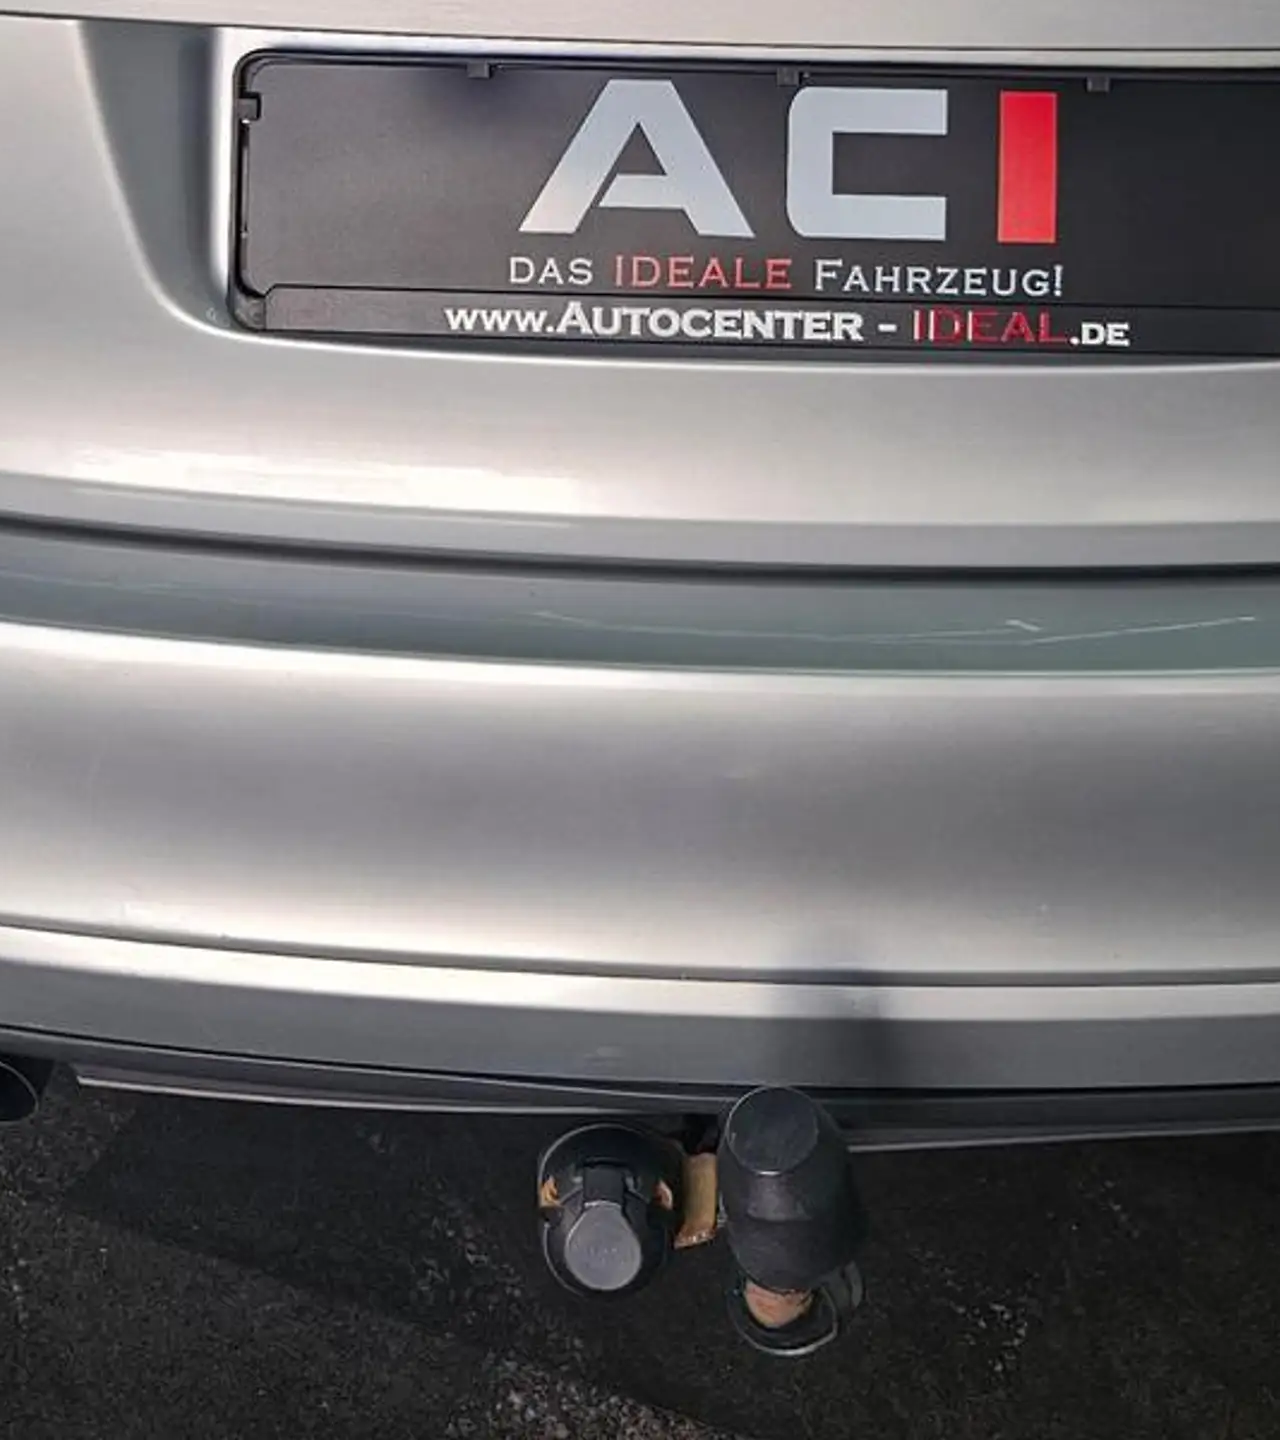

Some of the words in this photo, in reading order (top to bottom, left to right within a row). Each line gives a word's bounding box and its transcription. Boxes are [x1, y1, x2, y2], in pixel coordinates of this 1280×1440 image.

[517, 78, 1058, 244] ACI
[508, 256, 594, 286] DAS
[614, 255, 793, 289] IDEALE
[813, 258, 1064, 297] FAHRZEUG!
[913, 309, 1129, 347] IDEAL.DE
